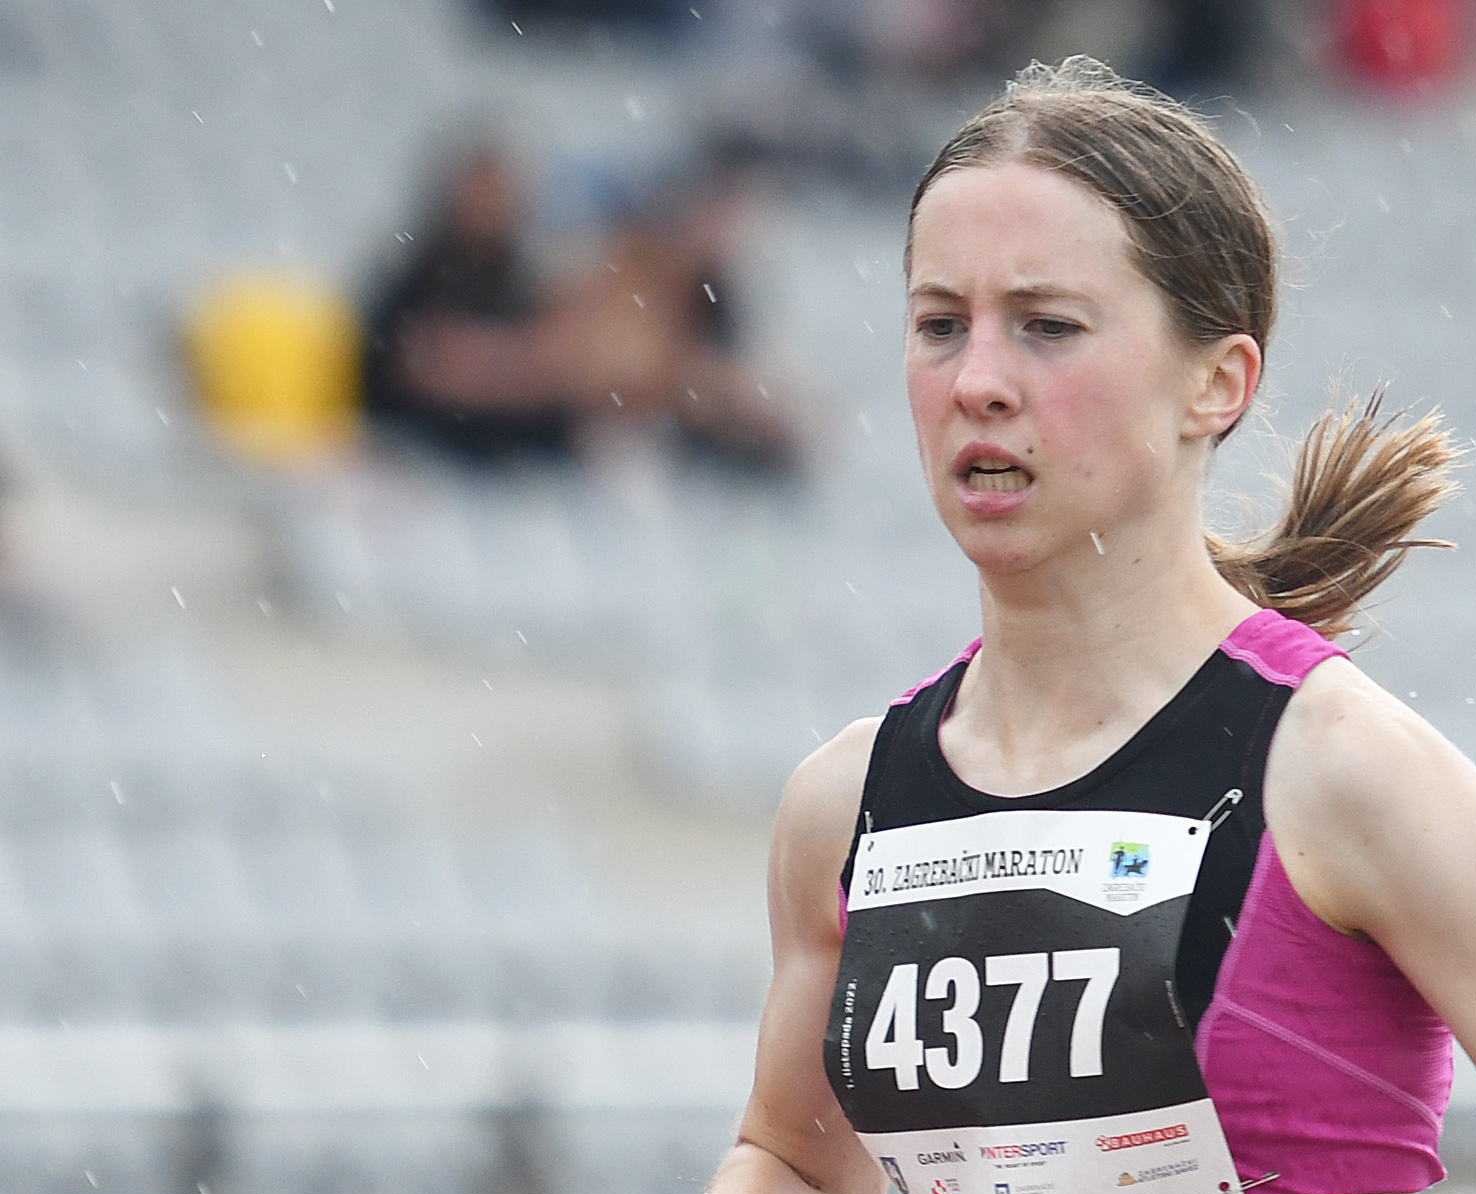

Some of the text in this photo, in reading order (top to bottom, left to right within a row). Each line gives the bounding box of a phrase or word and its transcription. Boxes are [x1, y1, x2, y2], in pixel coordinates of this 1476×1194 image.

[864, 867, 887, 896] 30.
[982, 848, 1085, 880] MARATON
[865, 947, 1121, 1091] 4377
[840, 1016, 853, 1077] listopada
[979, 1140, 1068, 1160] INTERSPORT
[1108, 1124, 1189, 1151] BAUHAUS
[917, 1149, 967, 1166] GARMIN
